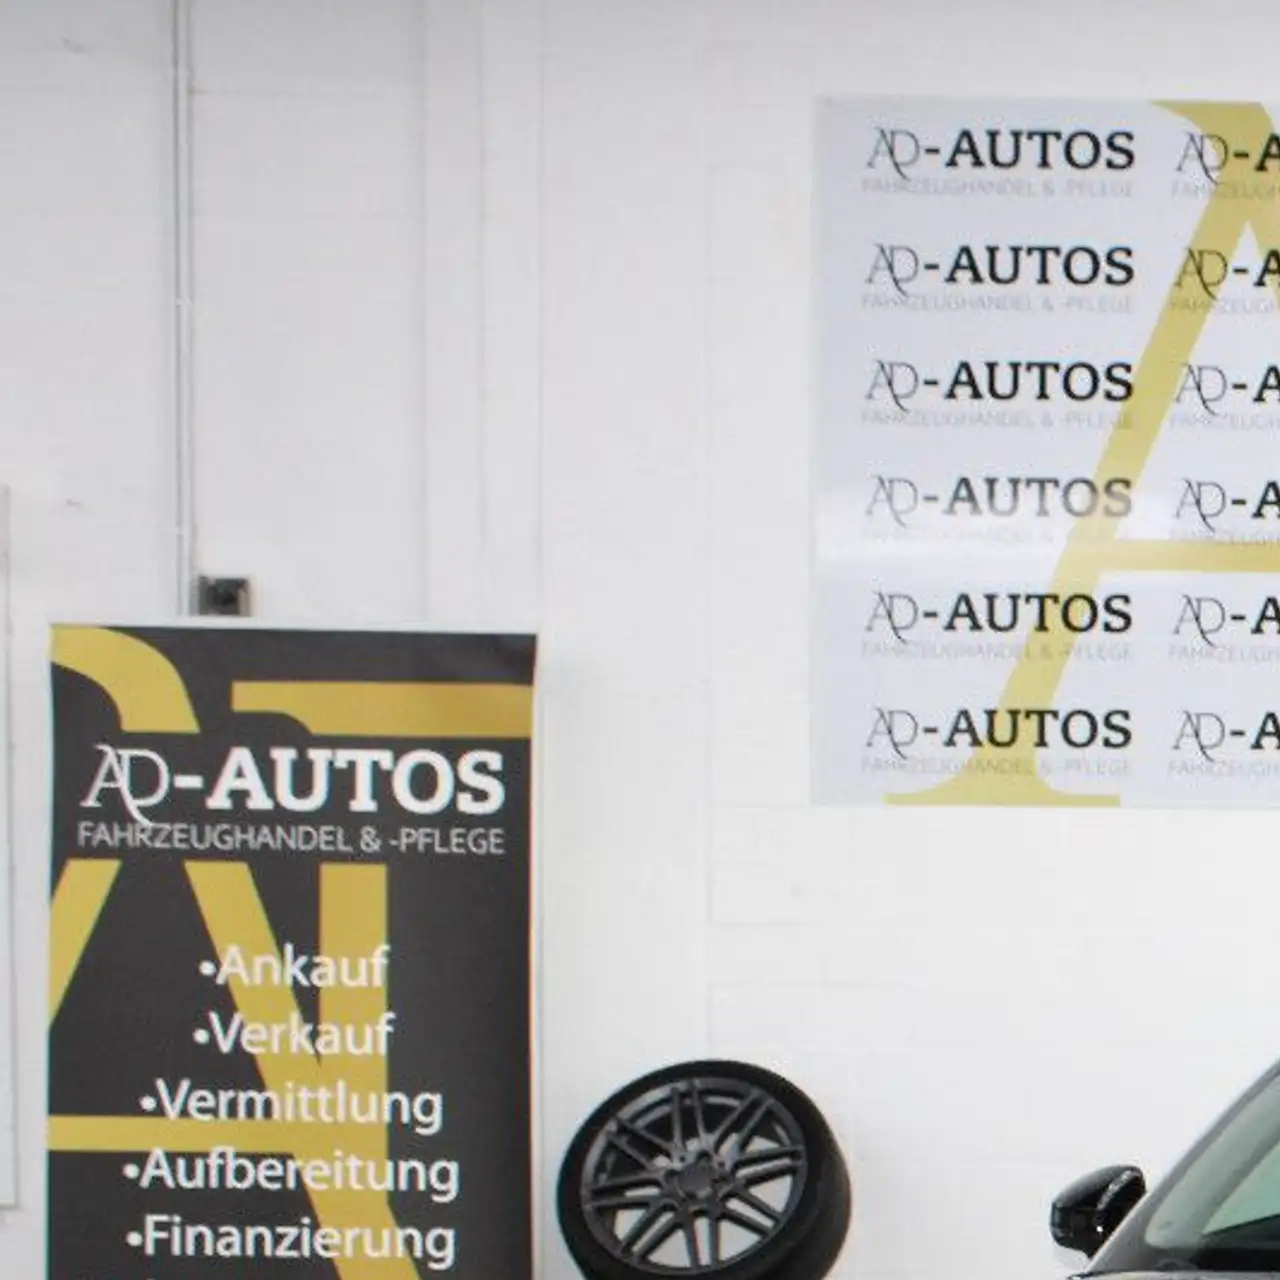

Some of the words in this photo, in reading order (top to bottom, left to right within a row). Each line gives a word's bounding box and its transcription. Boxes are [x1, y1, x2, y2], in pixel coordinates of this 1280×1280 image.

[866, 128, 1135, 179] AD-AUTOS
[865, 243, 1134, 297] AD-AUTOS
[865, 359, 1133, 413] AD-AUTOS
[865, 475, 1132, 529] AD-AUTOS
[865, 590, 1132, 644] AD-AUTOS
[865, 707, 1132, 760] AD-AUTOS
[79, 745, 506, 827] AD-AUTOS
[77, 821, 353, 852] FAHRZEUGHANDEL
[360, 826, 381, 853] &
[389, 827, 506, 855] -PFLEGE
[215, 943, 391, 987] Ankauf
[208, 1011, 396, 1056] Verkauf
[154, 1079, 443, 1135] Vermittlung
[139, 1148, 459, 1203] Aufbereitung
[144, 1214, 456, 1270] Finanzierung
